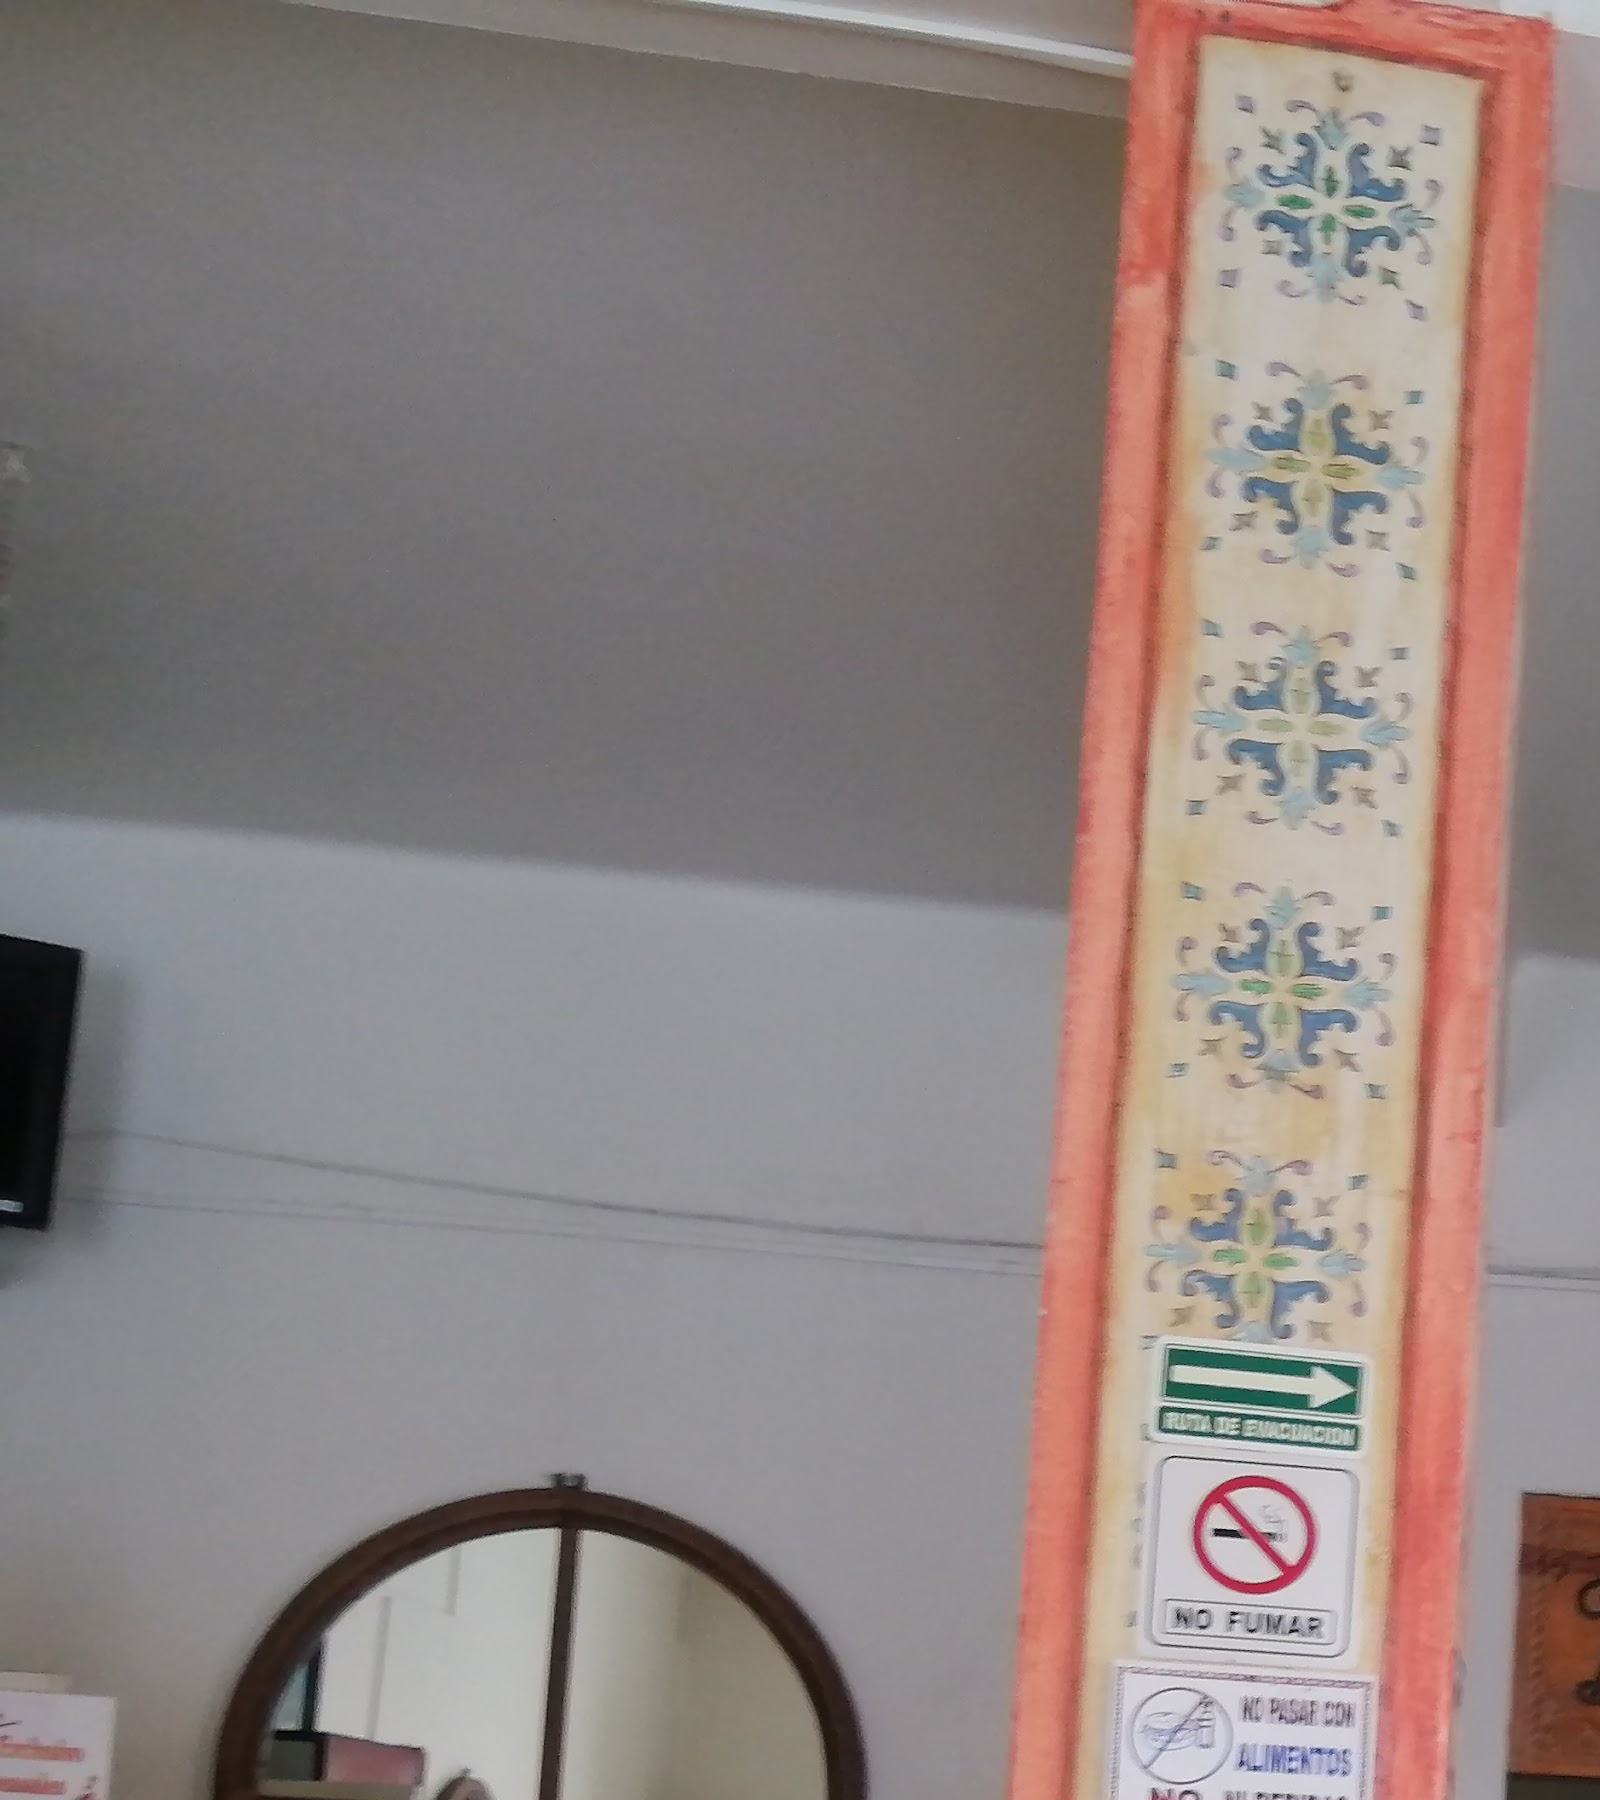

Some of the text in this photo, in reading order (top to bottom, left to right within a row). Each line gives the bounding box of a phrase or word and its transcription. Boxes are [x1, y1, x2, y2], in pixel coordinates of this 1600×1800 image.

[1163, 1411, 1212, 1432] RUTA
[1213, 1415, 1241, 1436] DE
[1172, 1607, 1326, 1639] NO FUMAR
[1241, 1696, 1355, 1728] NO PASAR CON
[1237, 1743, 1352, 1777] ALIMENTOS
